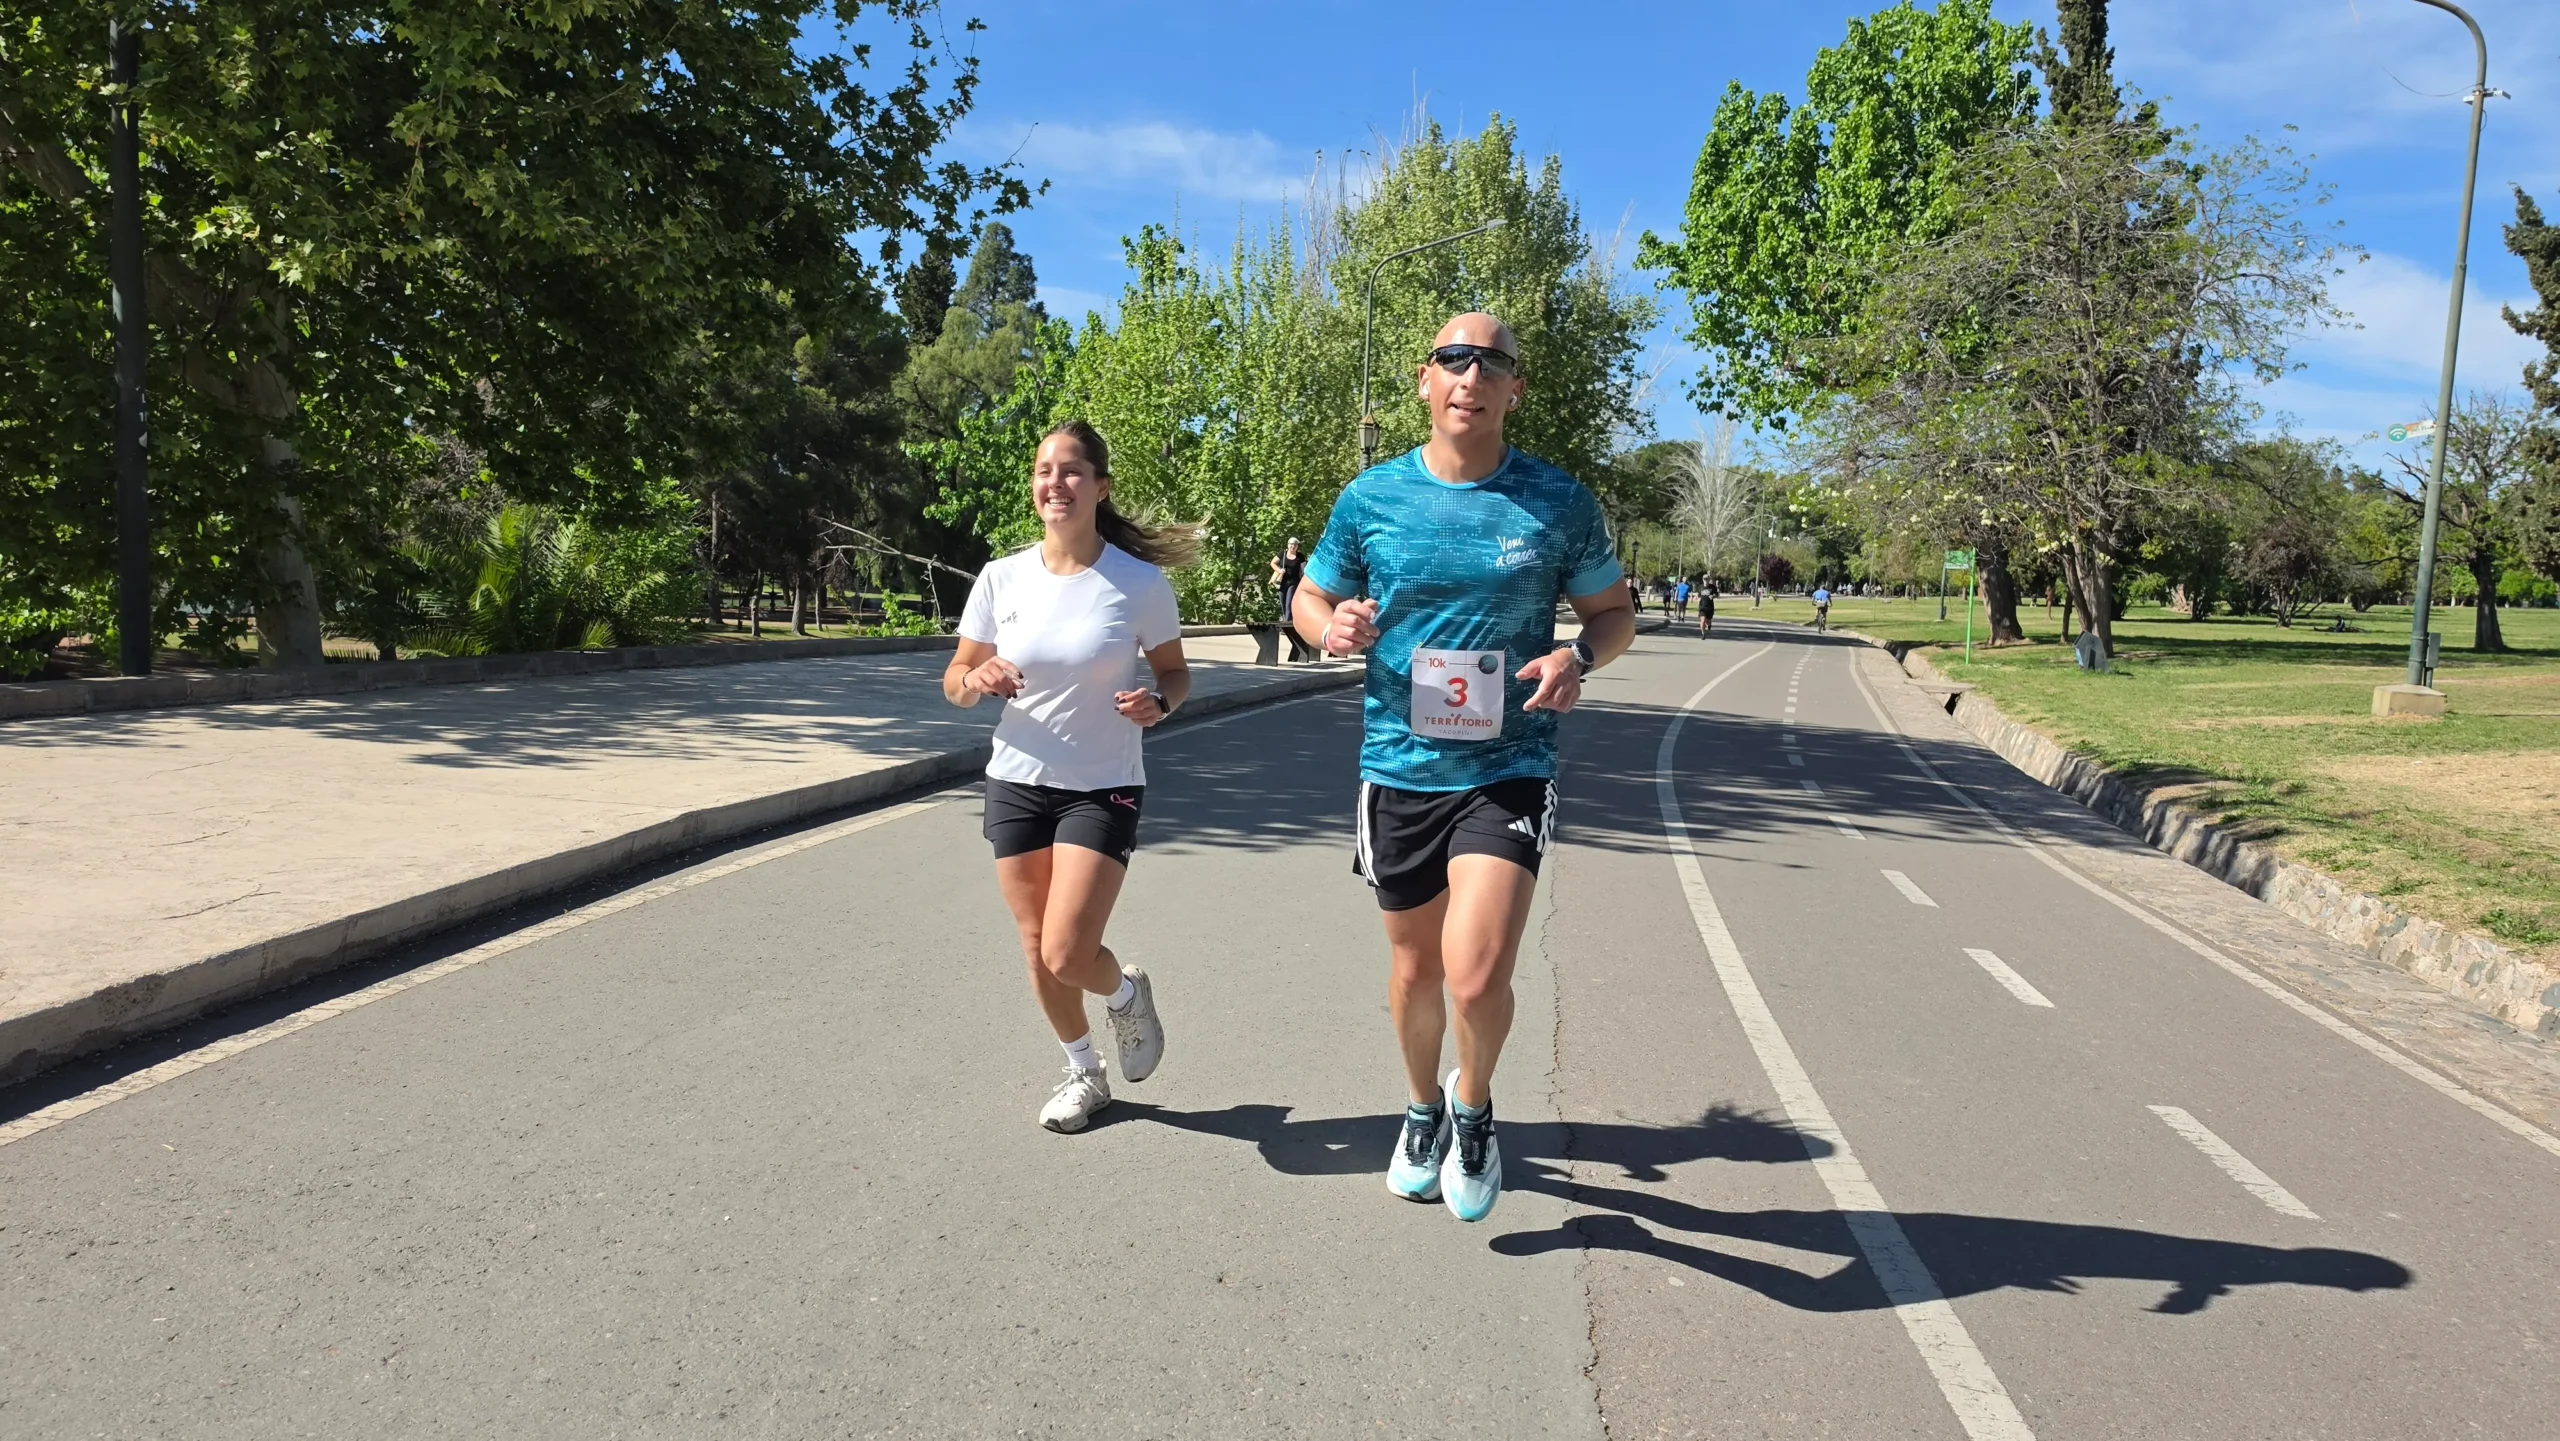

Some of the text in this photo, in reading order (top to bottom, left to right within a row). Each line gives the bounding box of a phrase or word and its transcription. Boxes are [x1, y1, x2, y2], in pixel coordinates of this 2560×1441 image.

[1496, 555, 1504, 567] a
[1428, 657, 1447, 668] 10k
[1443, 677, 1469, 708] 3
[1424, 713, 1493, 727] TERRITORIO
